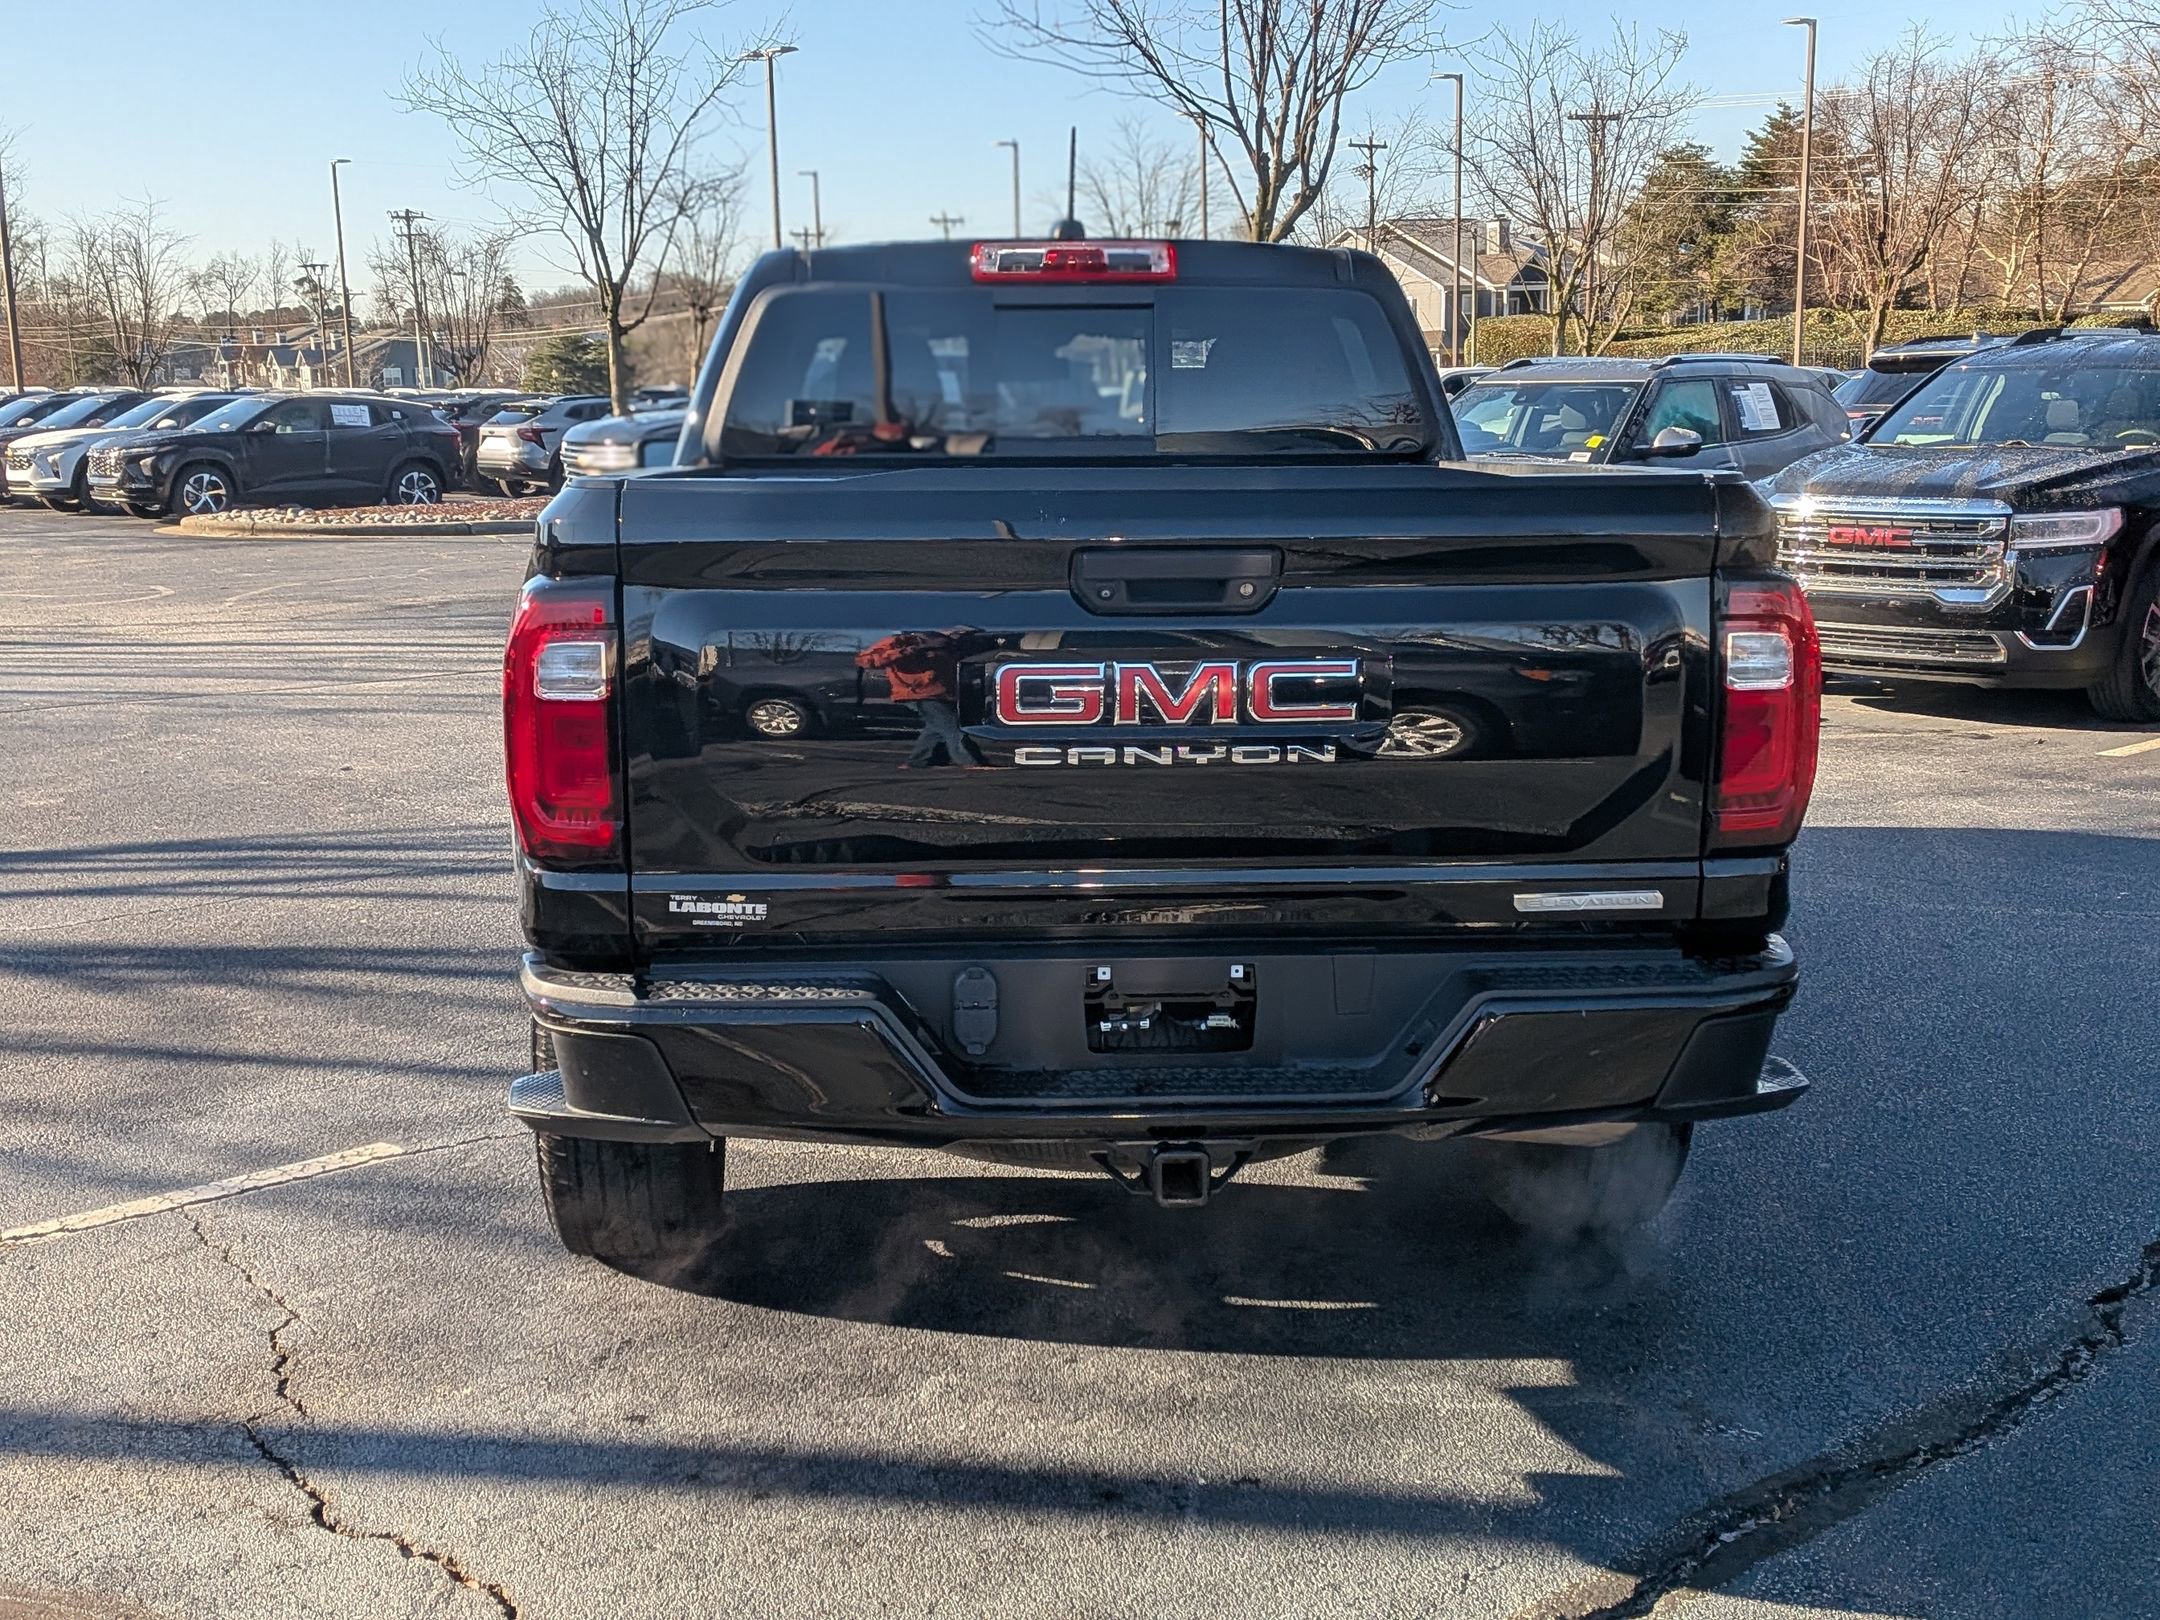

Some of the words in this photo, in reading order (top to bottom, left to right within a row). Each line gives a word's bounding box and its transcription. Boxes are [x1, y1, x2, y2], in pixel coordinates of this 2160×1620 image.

[1829, 527, 1913, 546] GMC
[995, 658, 1357, 726] GMC
[1014, 746, 1336, 765] CANYON
[669, 901, 767, 914] LABONTE
[1525, 895, 1650, 908] ELEVATION
